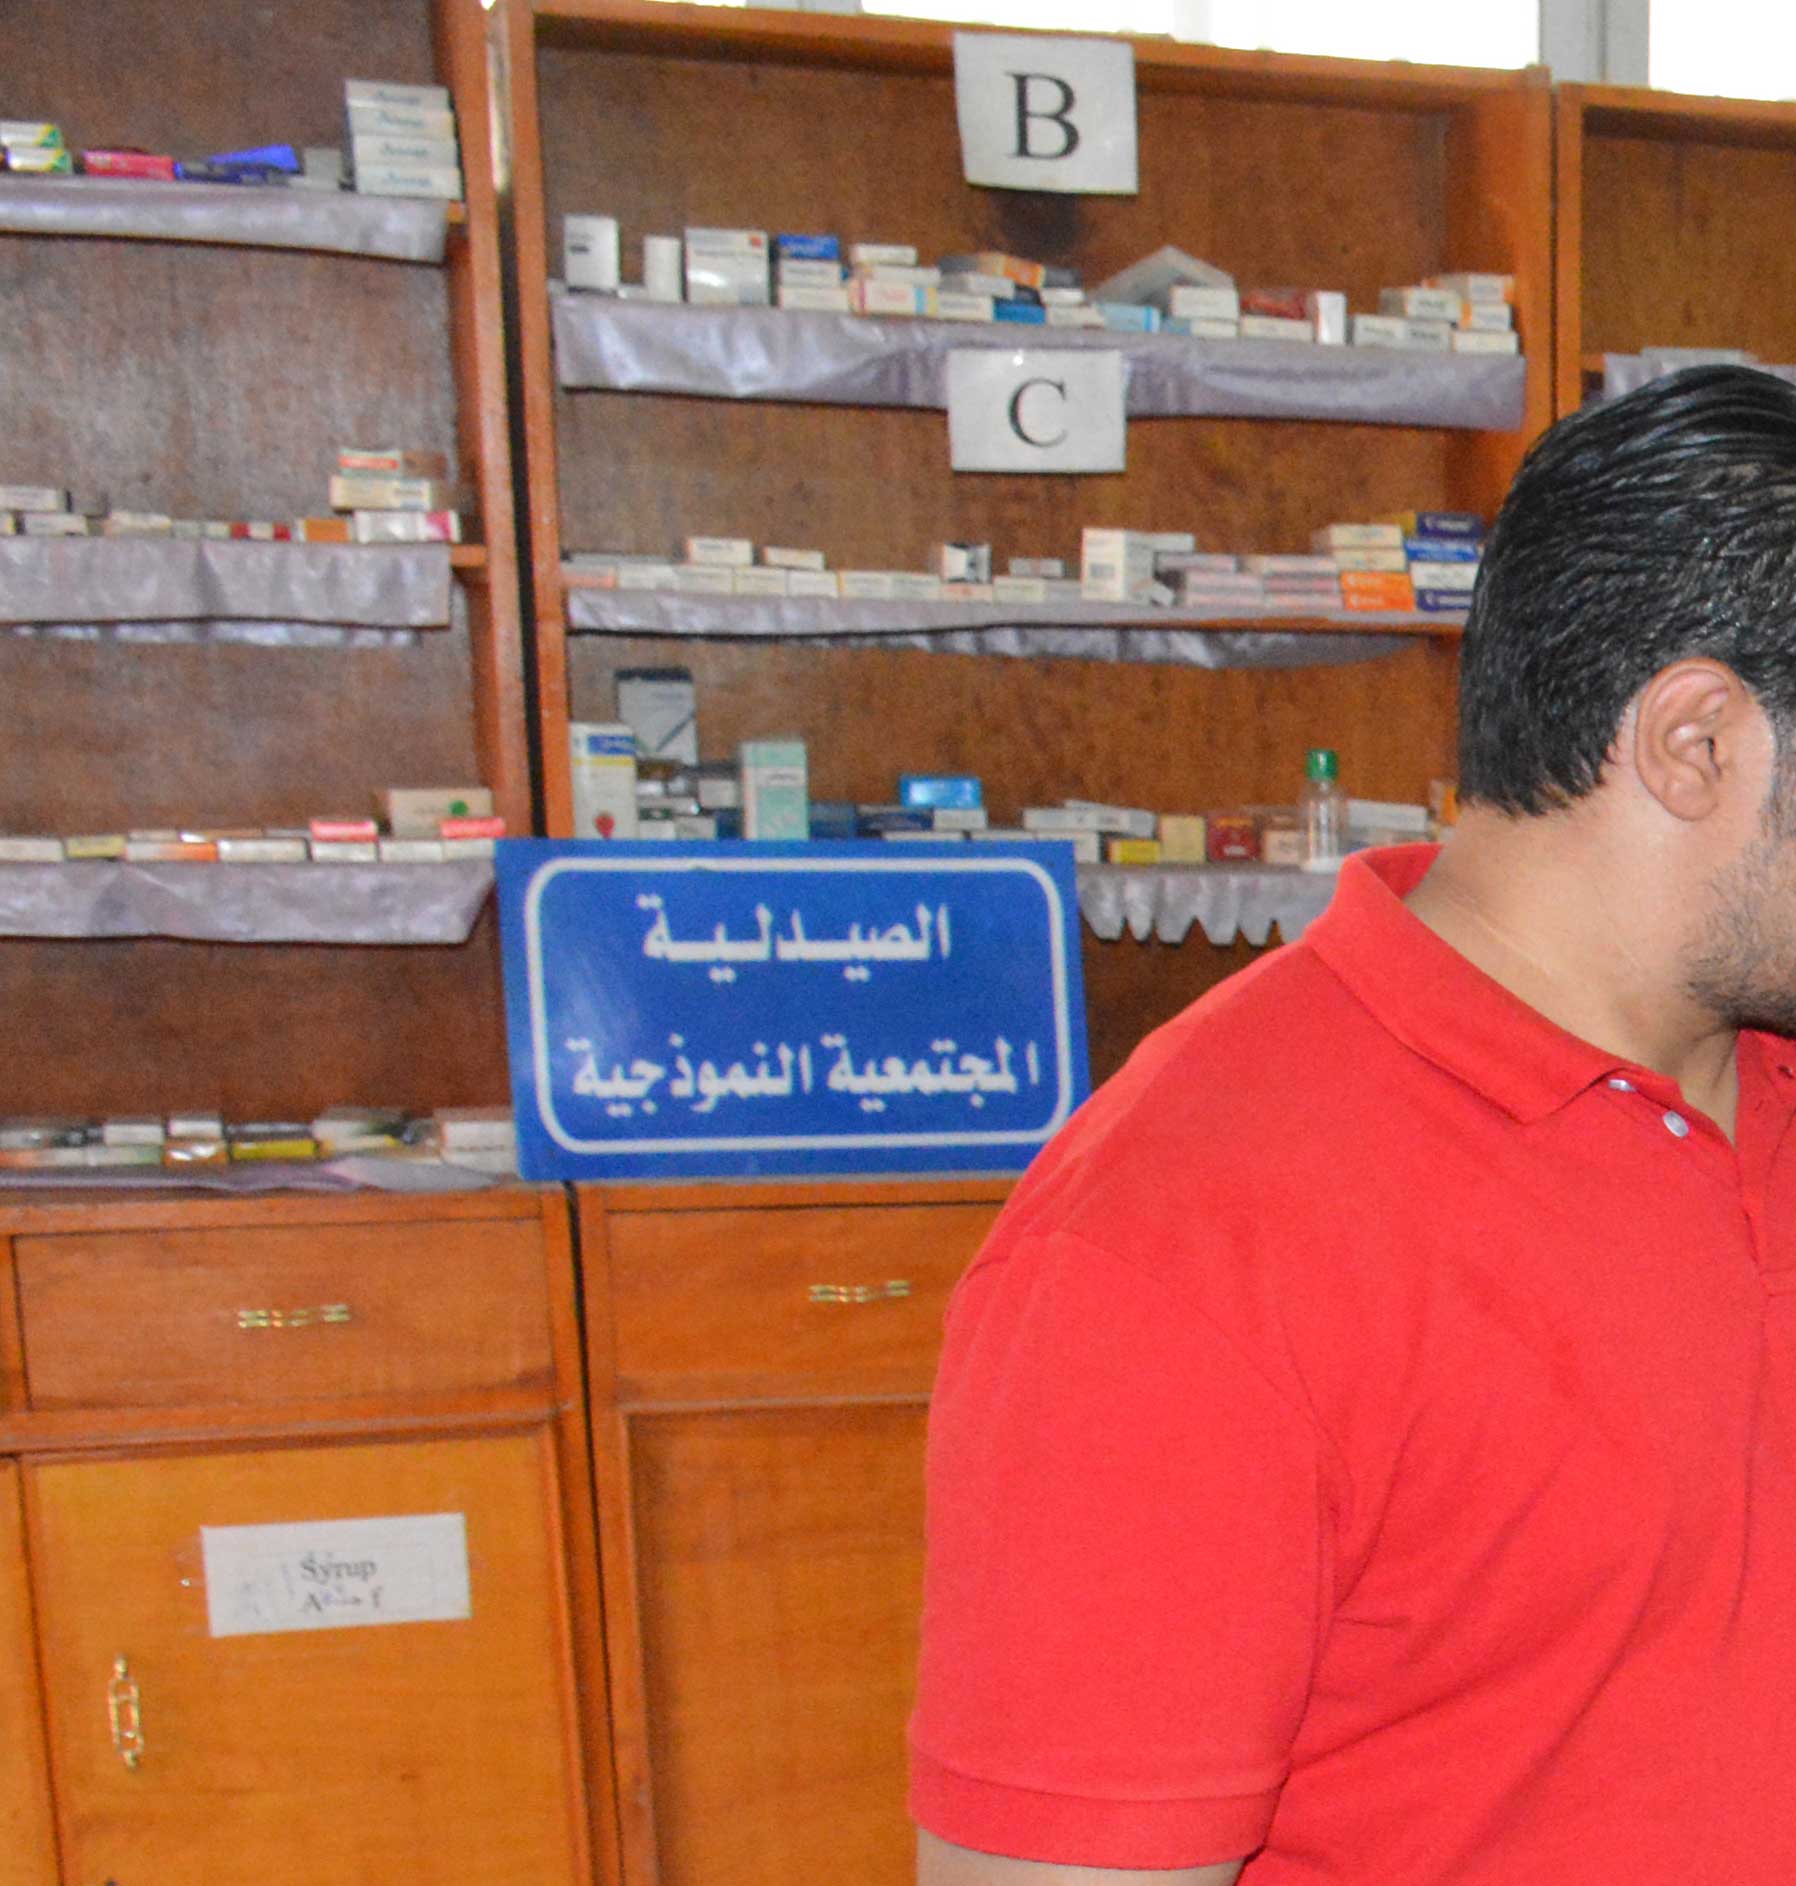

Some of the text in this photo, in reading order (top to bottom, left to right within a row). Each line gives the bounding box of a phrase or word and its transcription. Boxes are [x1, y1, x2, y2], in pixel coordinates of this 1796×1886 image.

[1005, 73, 1079, 159] B
[1009, 378, 1068, 447] C
[635, 894, 951, 982] الصيدلية
[565, 1033, 1040, 1118] المجتمعية النموذجية
[300, 1554, 377, 1584] Syrup
